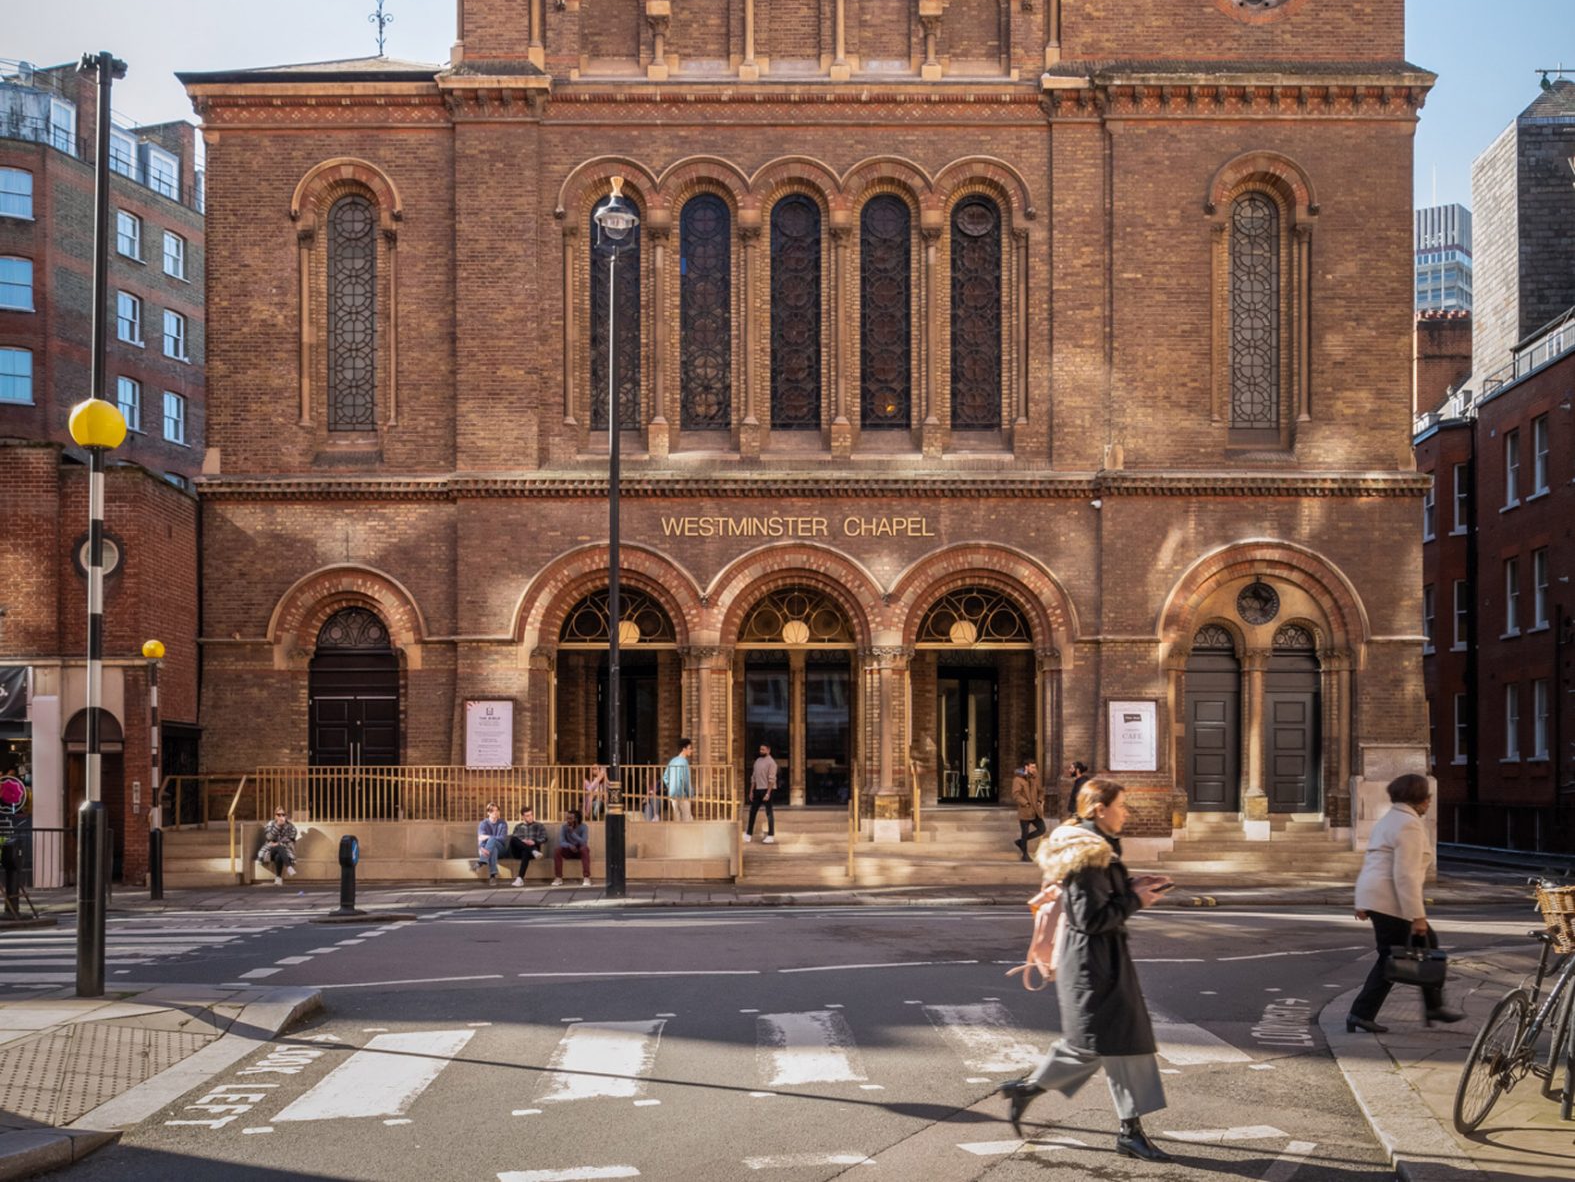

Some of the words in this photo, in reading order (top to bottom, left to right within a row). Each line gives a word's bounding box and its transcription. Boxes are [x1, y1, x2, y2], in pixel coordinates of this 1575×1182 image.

[661, 517, 828, 536] WESTMINSTER
[844, 517, 935, 536] CHAPEL
[236, 1044, 335, 1075] LOOK
[164, 1083, 281, 1129] LEFT
